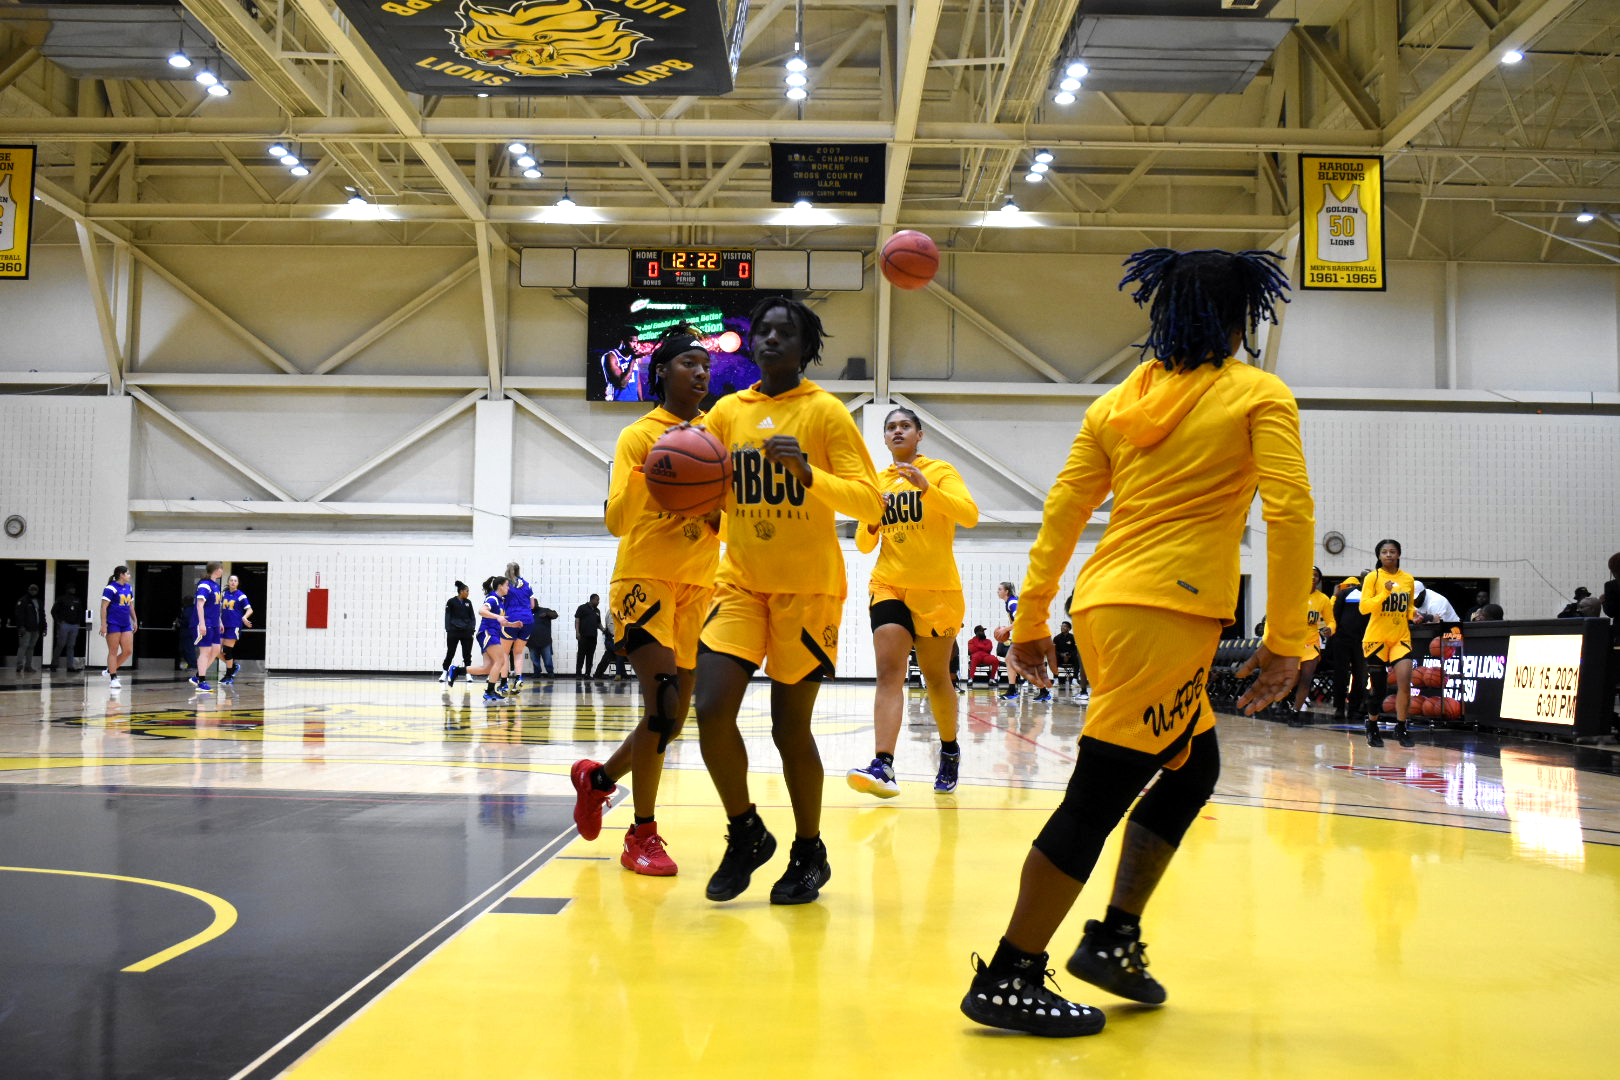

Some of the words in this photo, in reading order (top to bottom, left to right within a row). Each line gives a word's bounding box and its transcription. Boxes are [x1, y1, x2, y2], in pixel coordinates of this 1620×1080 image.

[415, 56, 511, 86] LIONS
[616, 58, 694, 86] UAPB
[821, 155, 870, 163] CHAMPIONS
[1319, 162, 1364, 172] HAROLD
[793, 171, 820, 180] CROSS
[826, 171, 863, 180] COUNTRY
[1318, 171, 1365, 181] BLEVINS
[1325, 206, 1358, 214] GOLDEN
[1329, 215, 1355, 238] 50
[1329, 238, 1355, 246] LIONS
[635, 251, 658, 259] HOME
[672, 252, 717, 268] 12:22
[722, 252, 751, 260] VISITOR
[648, 261, 659, 278] 0
[738, 262, 749, 278] 0
[119, 593, 132, 606] M
[222, 599, 235, 611] M
[1477, 655, 1505, 680] LIONS
[1554, 666, 1579, 691] 2021
[1536, 693, 1557, 718] 6:30
[1558, 694, 1577, 719] PM
